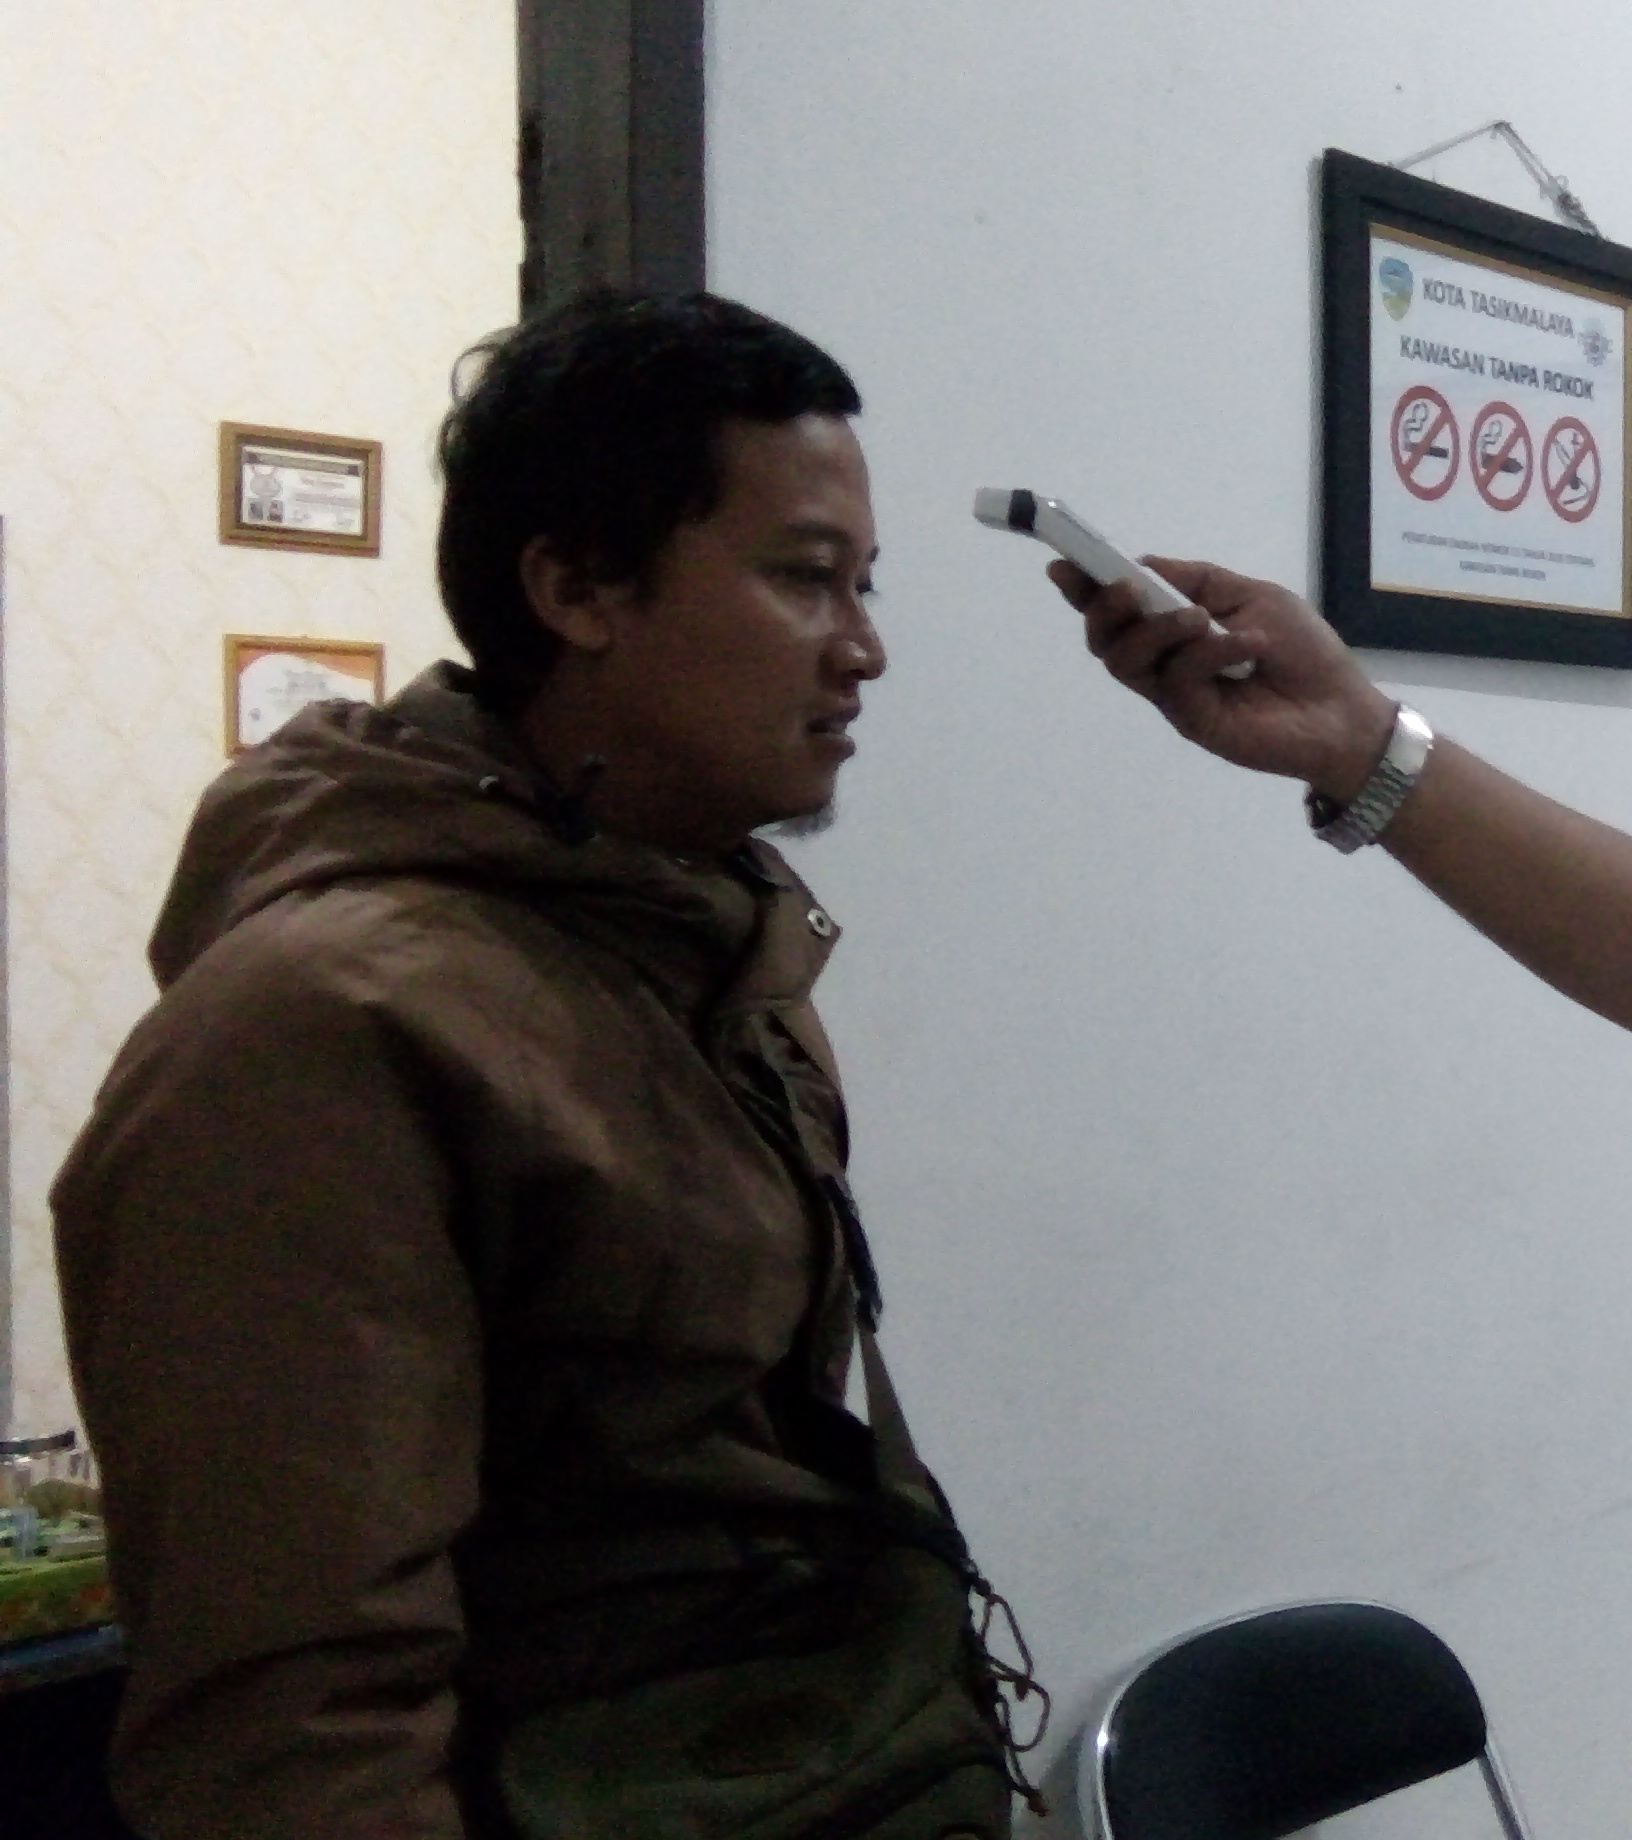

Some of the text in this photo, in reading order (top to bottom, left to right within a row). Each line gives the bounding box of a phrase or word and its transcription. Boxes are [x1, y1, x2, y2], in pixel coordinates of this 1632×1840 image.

[1422, 277, 1575, 338] KOTA TASIKMALAYA
[1400, 335, 1594, 401] KAWASAN TANPA ROKOK
